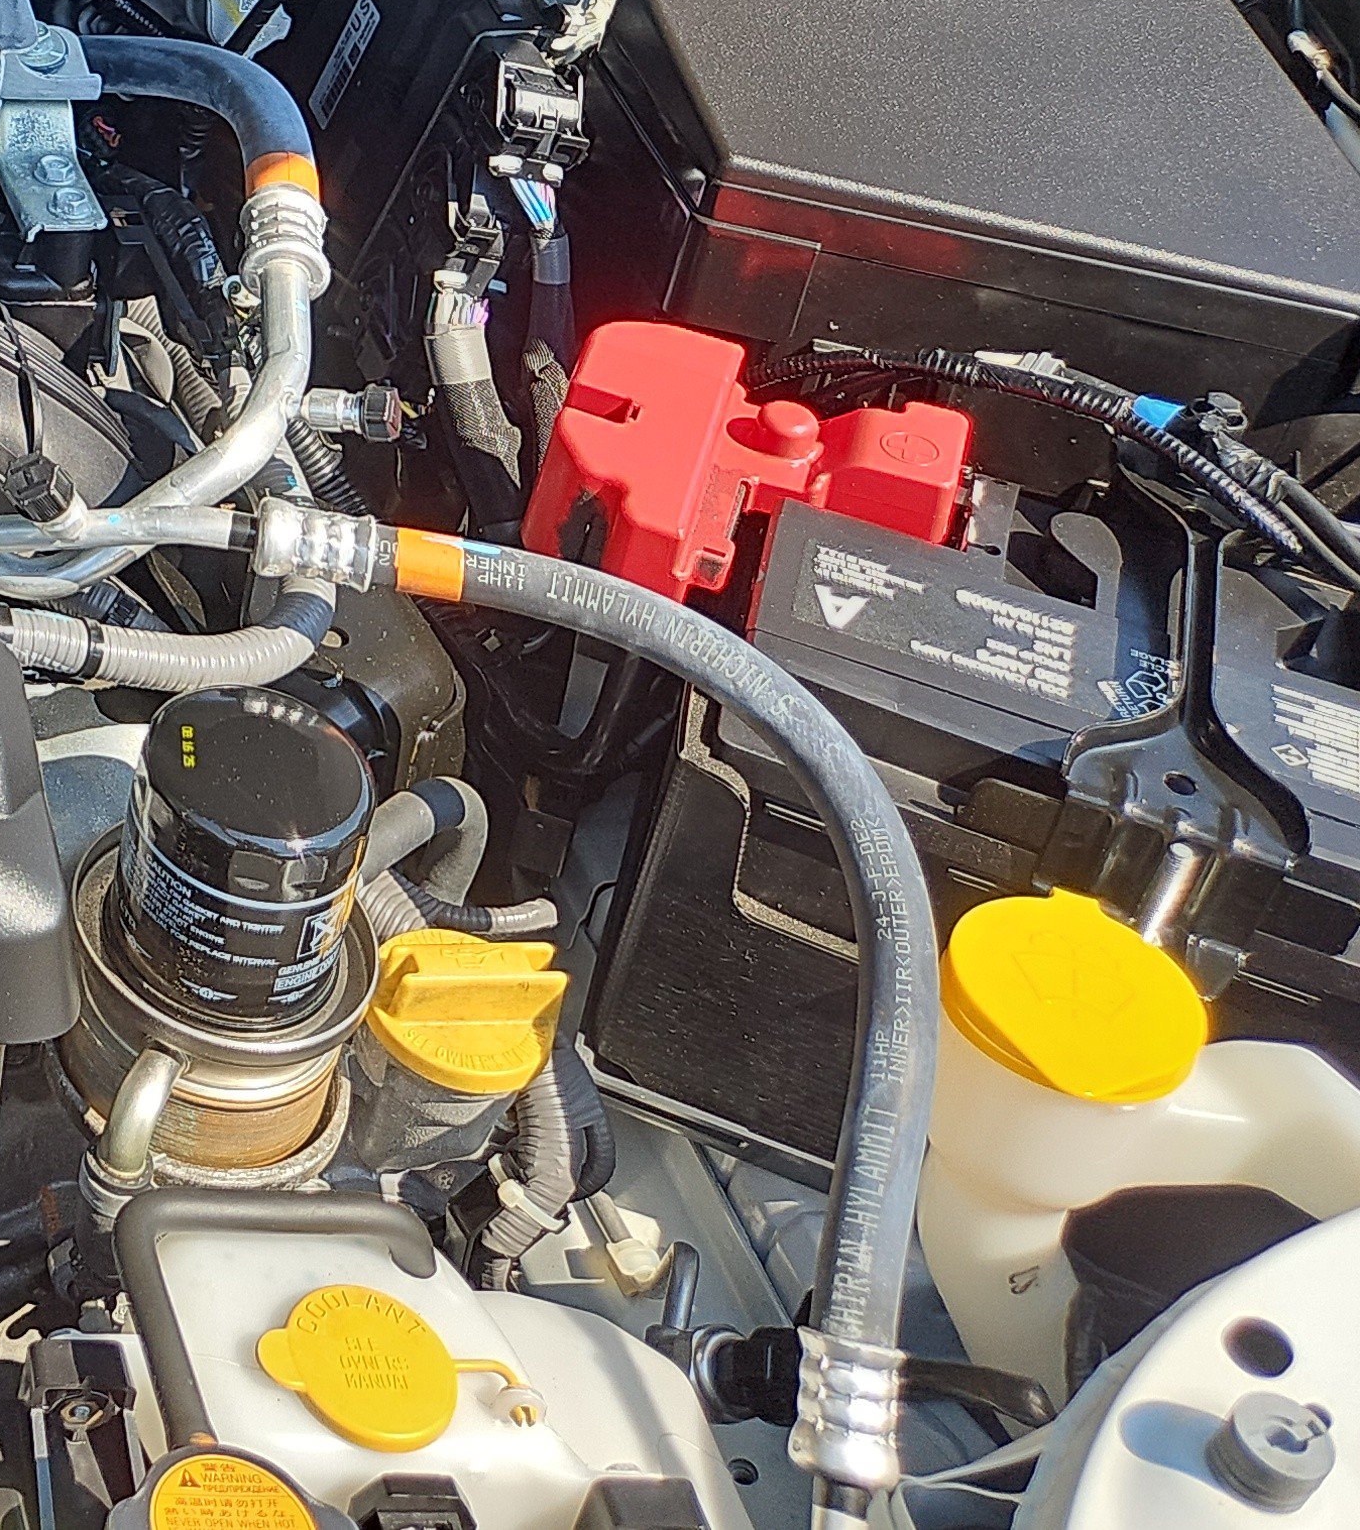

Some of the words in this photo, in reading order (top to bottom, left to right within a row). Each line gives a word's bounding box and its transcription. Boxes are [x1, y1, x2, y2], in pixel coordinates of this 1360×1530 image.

[546, 571, 656, 631] HYLAMMIT
[144, 853, 194, 899] CAUTION
[844, 1103, 899, 1230] HYLAMMIT
[296, 1290, 427, 1335] COOLANT
[200, 1472, 262, 1484] WARNING
[166, 1517, 201, 1528] NEVER
[205, 1517, 233, 1527] OPEN
[237, 1517, 270, 1528] WHEN
[275, 1517, 296, 1527] HOT
